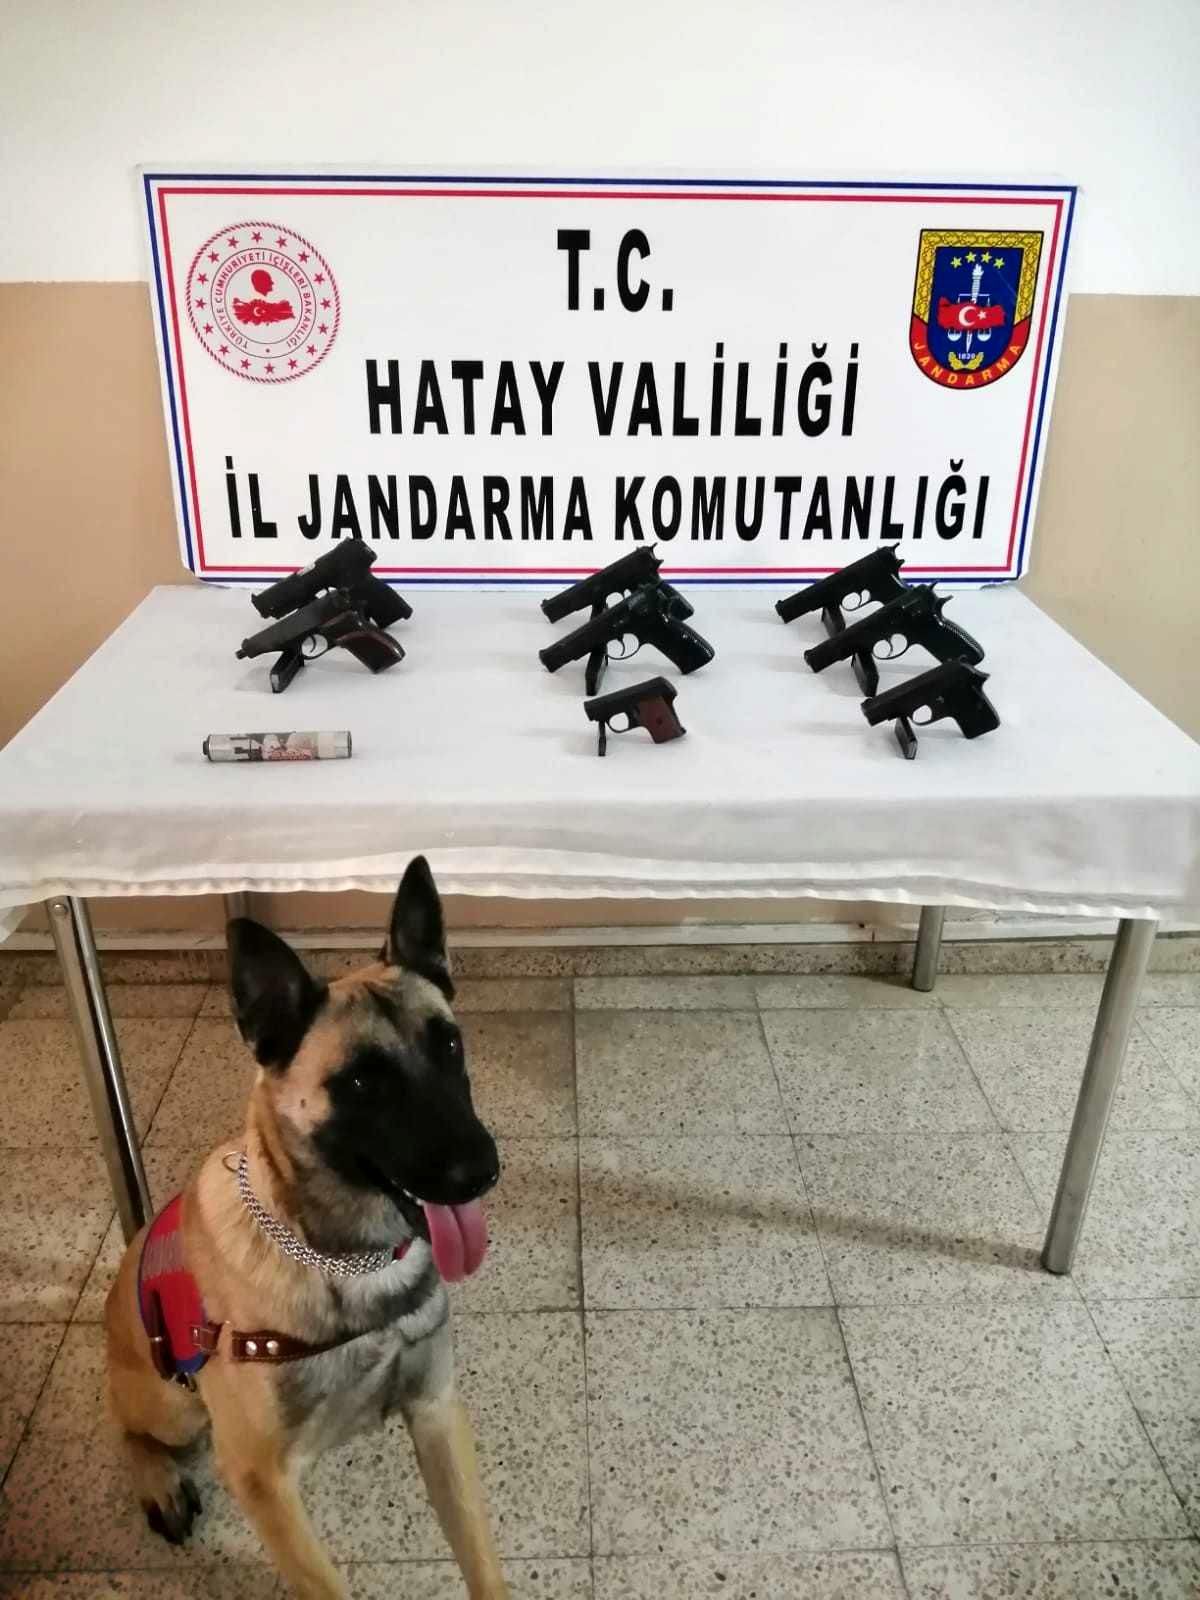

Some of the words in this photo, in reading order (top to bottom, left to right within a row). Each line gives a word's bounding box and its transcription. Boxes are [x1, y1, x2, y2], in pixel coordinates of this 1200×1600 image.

[215, 251, 265, 303] CUMHURİYETİ
[557, 229, 674, 312] T.C.
[216, 307, 248, 349] TÜRKİYE
[287, 292, 313, 348] BAKANLIĞI
[366, 360, 564, 435] HATAY
[588, 343, 858, 437] VALİLİĞİ
[914, 342, 1021, 385] JANDARMA
[226, 456, 277, 538] İL
[298, 475, 592, 541] JANDARMA
[615, 459, 989, 541] KOMUTANLIĞI
